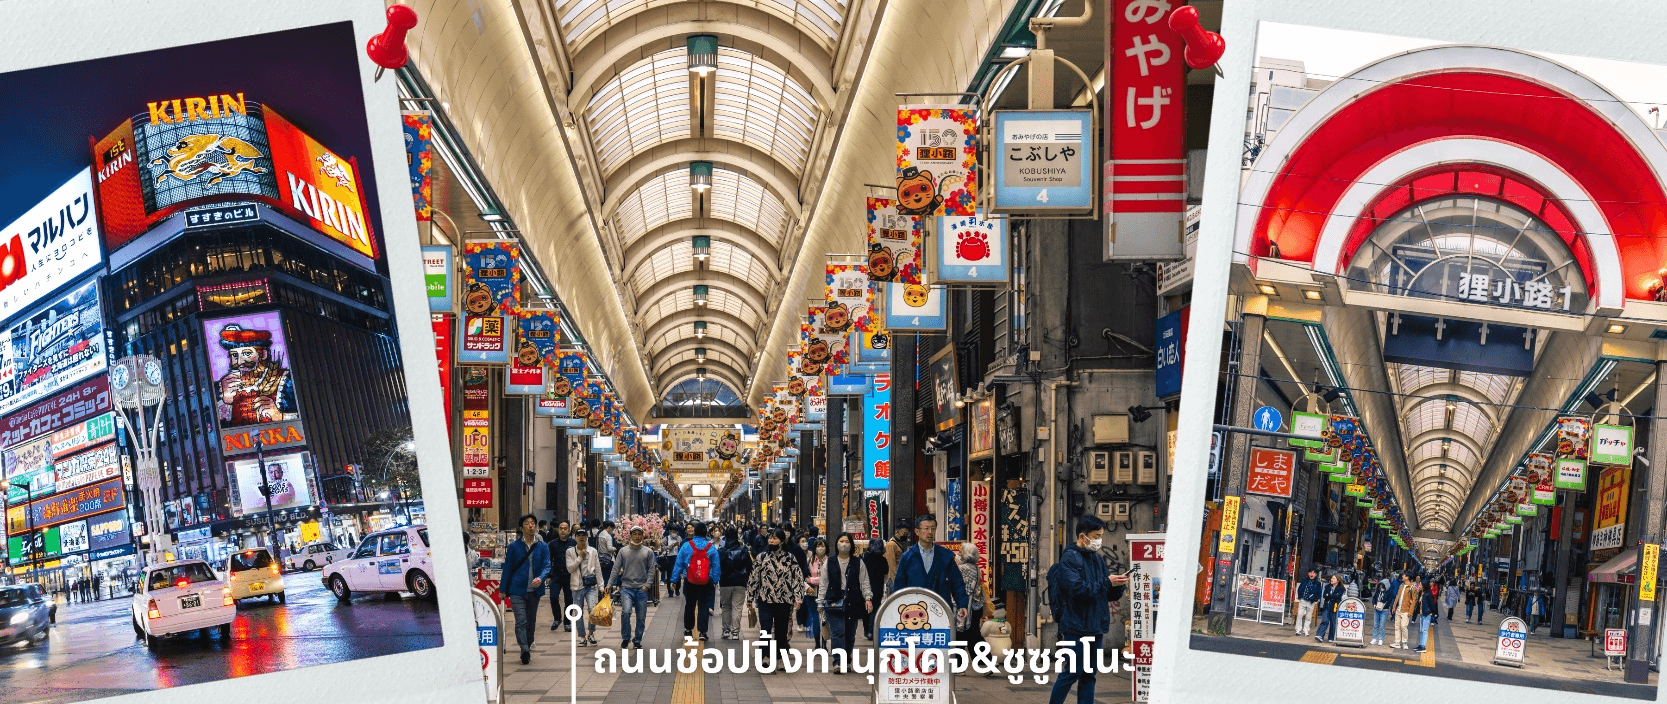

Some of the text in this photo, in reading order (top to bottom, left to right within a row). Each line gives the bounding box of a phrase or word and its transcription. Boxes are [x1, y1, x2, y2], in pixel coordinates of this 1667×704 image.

[1124, 0, 1173, 130] みやげ
[147, 92, 247, 126] KIRIN
[919, 128, 958, 148] 150
[1012, 133, 1049, 141] おみやげの店
[919, 148, 955, 160] 狸小路
[1009, 146, 1076, 162] こぶしや
[98, 149, 133, 184] KIRIN
[1036, 188, 1050, 203] 4
[189, 208, 254, 224] すすきのビル
[286, 170, 367, 247] KIRIN
[27, 191, 89, 255] マルハン
[31, 226, 93, 272] 人生にヨロコビを
[479, 269, 507, 277] 狸小路
[968, 266, 978, 278] 4
[1458, 272, 1572, 311] 狸小路1
[484, 319, 499, 334] 薬
[911, 316, 920, 326] 4
[466, 342, 501, 350] サンドラッグ
[881, 349, 888, 358] 4
[480, 351, 487, 359] 4
[1157, 340, 1180, 370] 白い恋人
[59, 390, 81, 406] 24H
[1, 390, 109, 447] ネットカフェコミック
[88, 414, 112, 439] 青汁
[223, 425, 304, 452] NIKKA
[464, 434, 487, 447] UFO
[1599, 437, 1626, 447] ガッチャ
[464, 453, 488, 464] 専門店
[1256, 451, 1288, 469] しま
[1251, 475, 1287, 493] だや
[245, 511, 309, 527] SUSUINO BLD.
[1000, 489, 1029, 537] パスタ
[1132, 563, 1143, 639] 手作り鞄の専門店
[1140, 643, 1154, 657] 免
[888, 677, 941, 685] 防犯カメラ作動中
